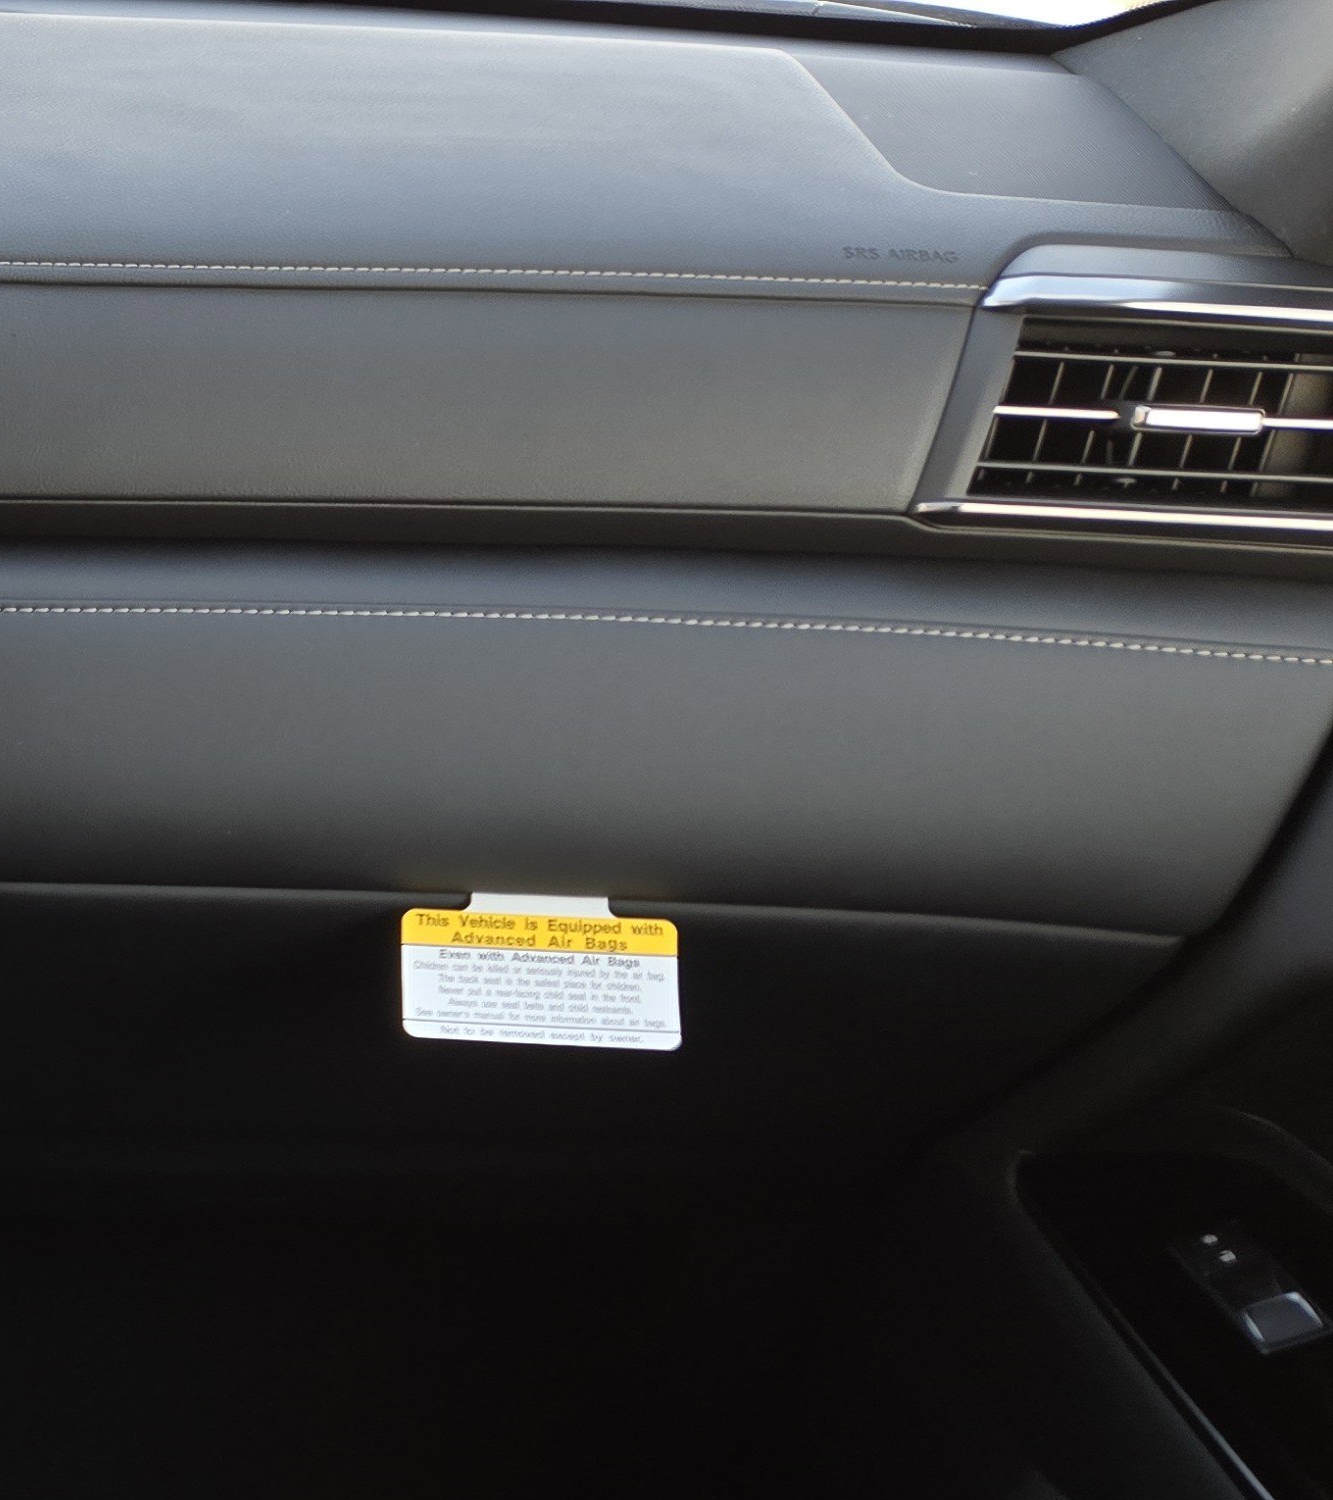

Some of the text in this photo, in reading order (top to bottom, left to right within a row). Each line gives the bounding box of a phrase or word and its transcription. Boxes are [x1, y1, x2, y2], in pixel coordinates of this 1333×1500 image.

[887, 248, 959, 264] AIRBAG
[415, 913, 664, 937] This Vehicle is Equipped with
[451, 931, 628, 953] Advanced Air Bags
[438, 949, 641, 969] Even with Advanced Air Bags
